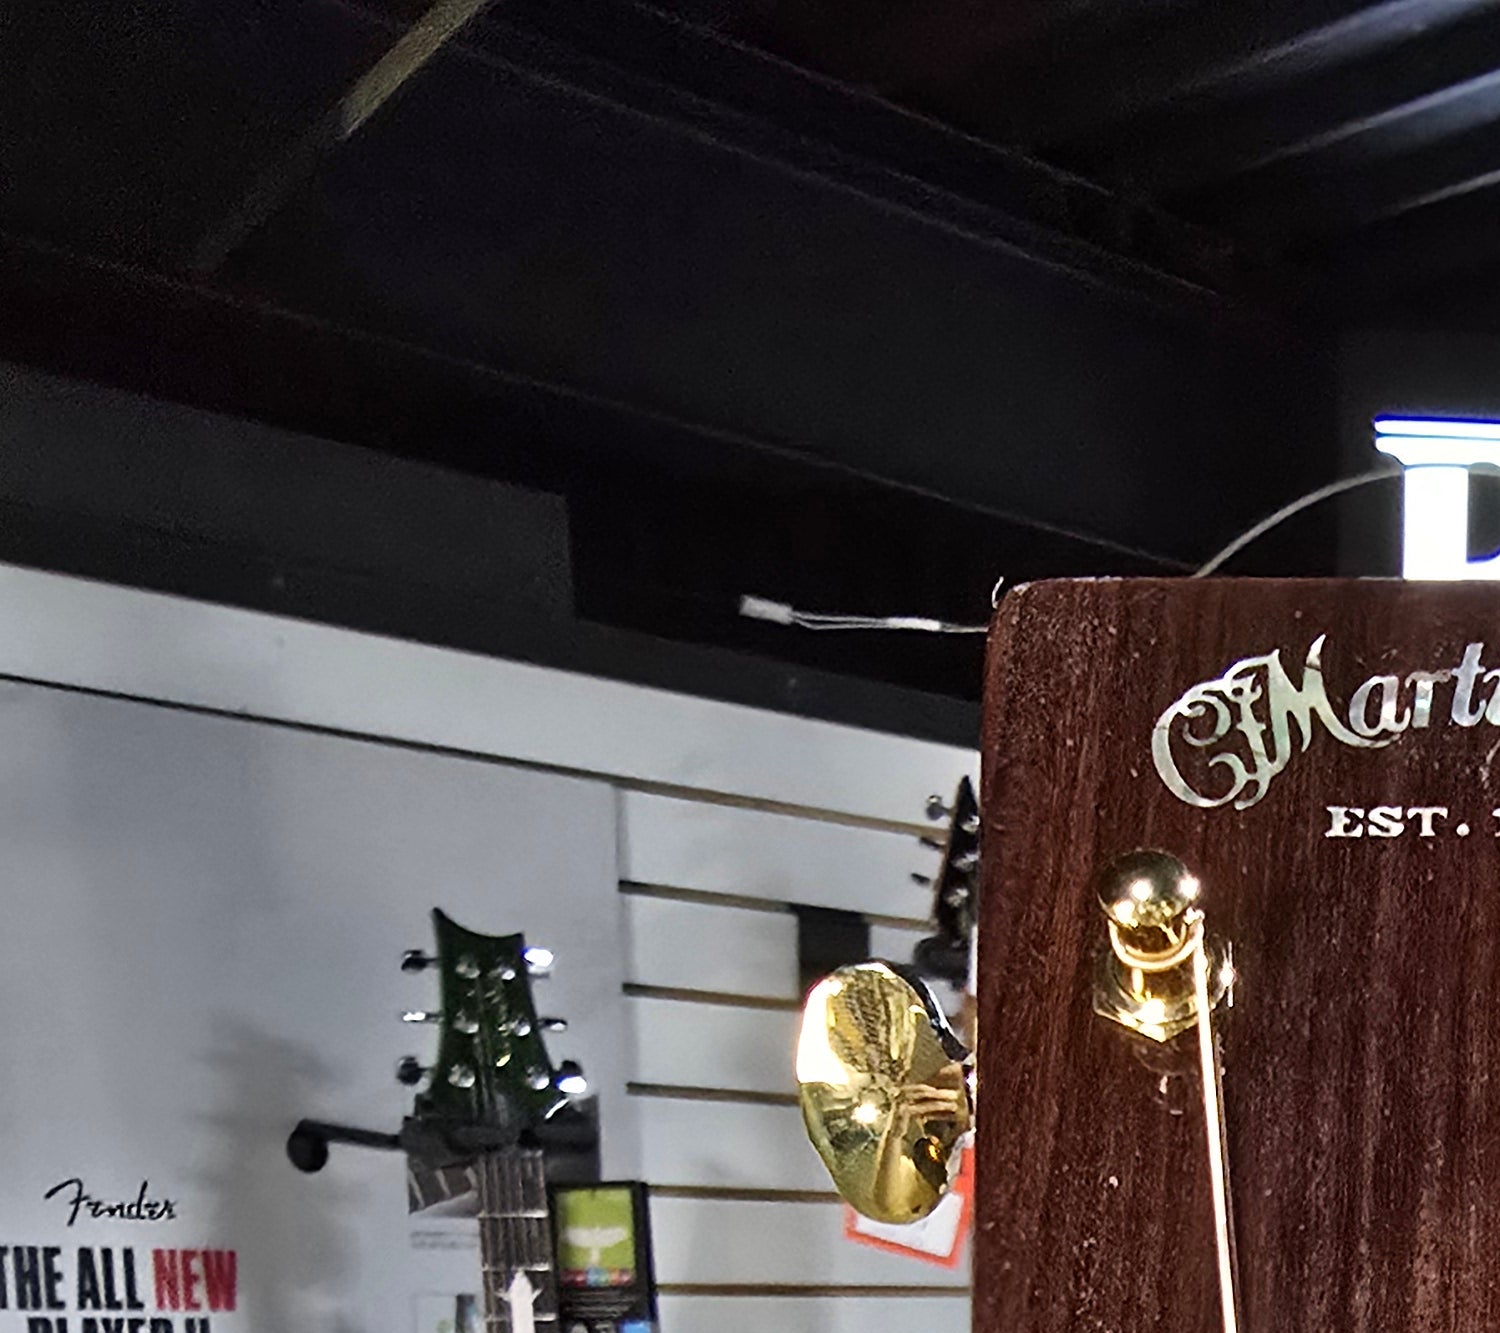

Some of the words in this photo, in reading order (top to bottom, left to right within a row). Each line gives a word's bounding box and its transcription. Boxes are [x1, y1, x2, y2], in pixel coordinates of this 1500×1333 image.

[1325, 805, 1471, 838] EST.
[44, 1178, 178, 1227] Fender
[77, 1247, 145, 1311] ALL
[152, 1248, 237, 1312] NEW
